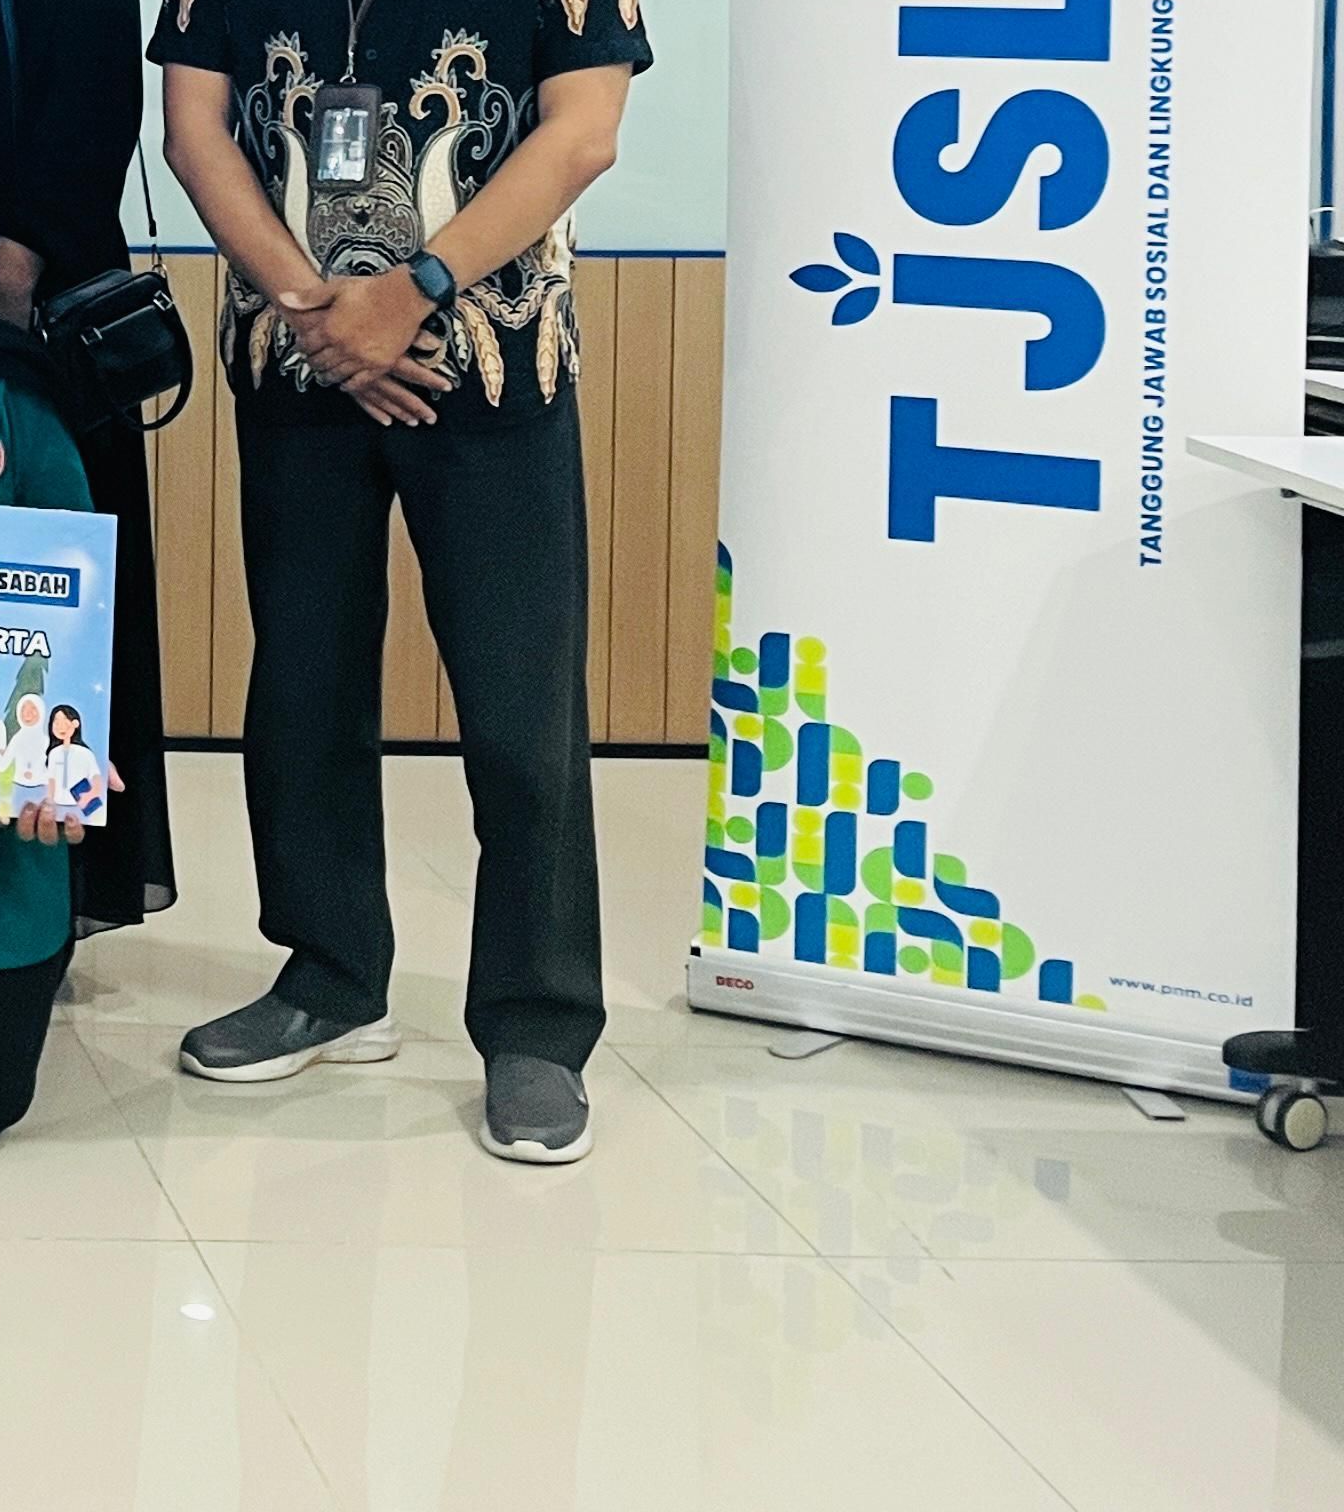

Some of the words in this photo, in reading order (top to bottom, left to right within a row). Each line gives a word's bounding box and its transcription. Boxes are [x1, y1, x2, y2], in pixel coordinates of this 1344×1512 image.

[1147, 142, 1170, 201] DAN
[1145, 206, 1169, 303] SOSIAL
[1143, 307, 1167, 408] JAWAB
[1139, 415, 1164, 567] TANGGUNG
[1108, 976, 1254, 1008] www.pnm.co.id
